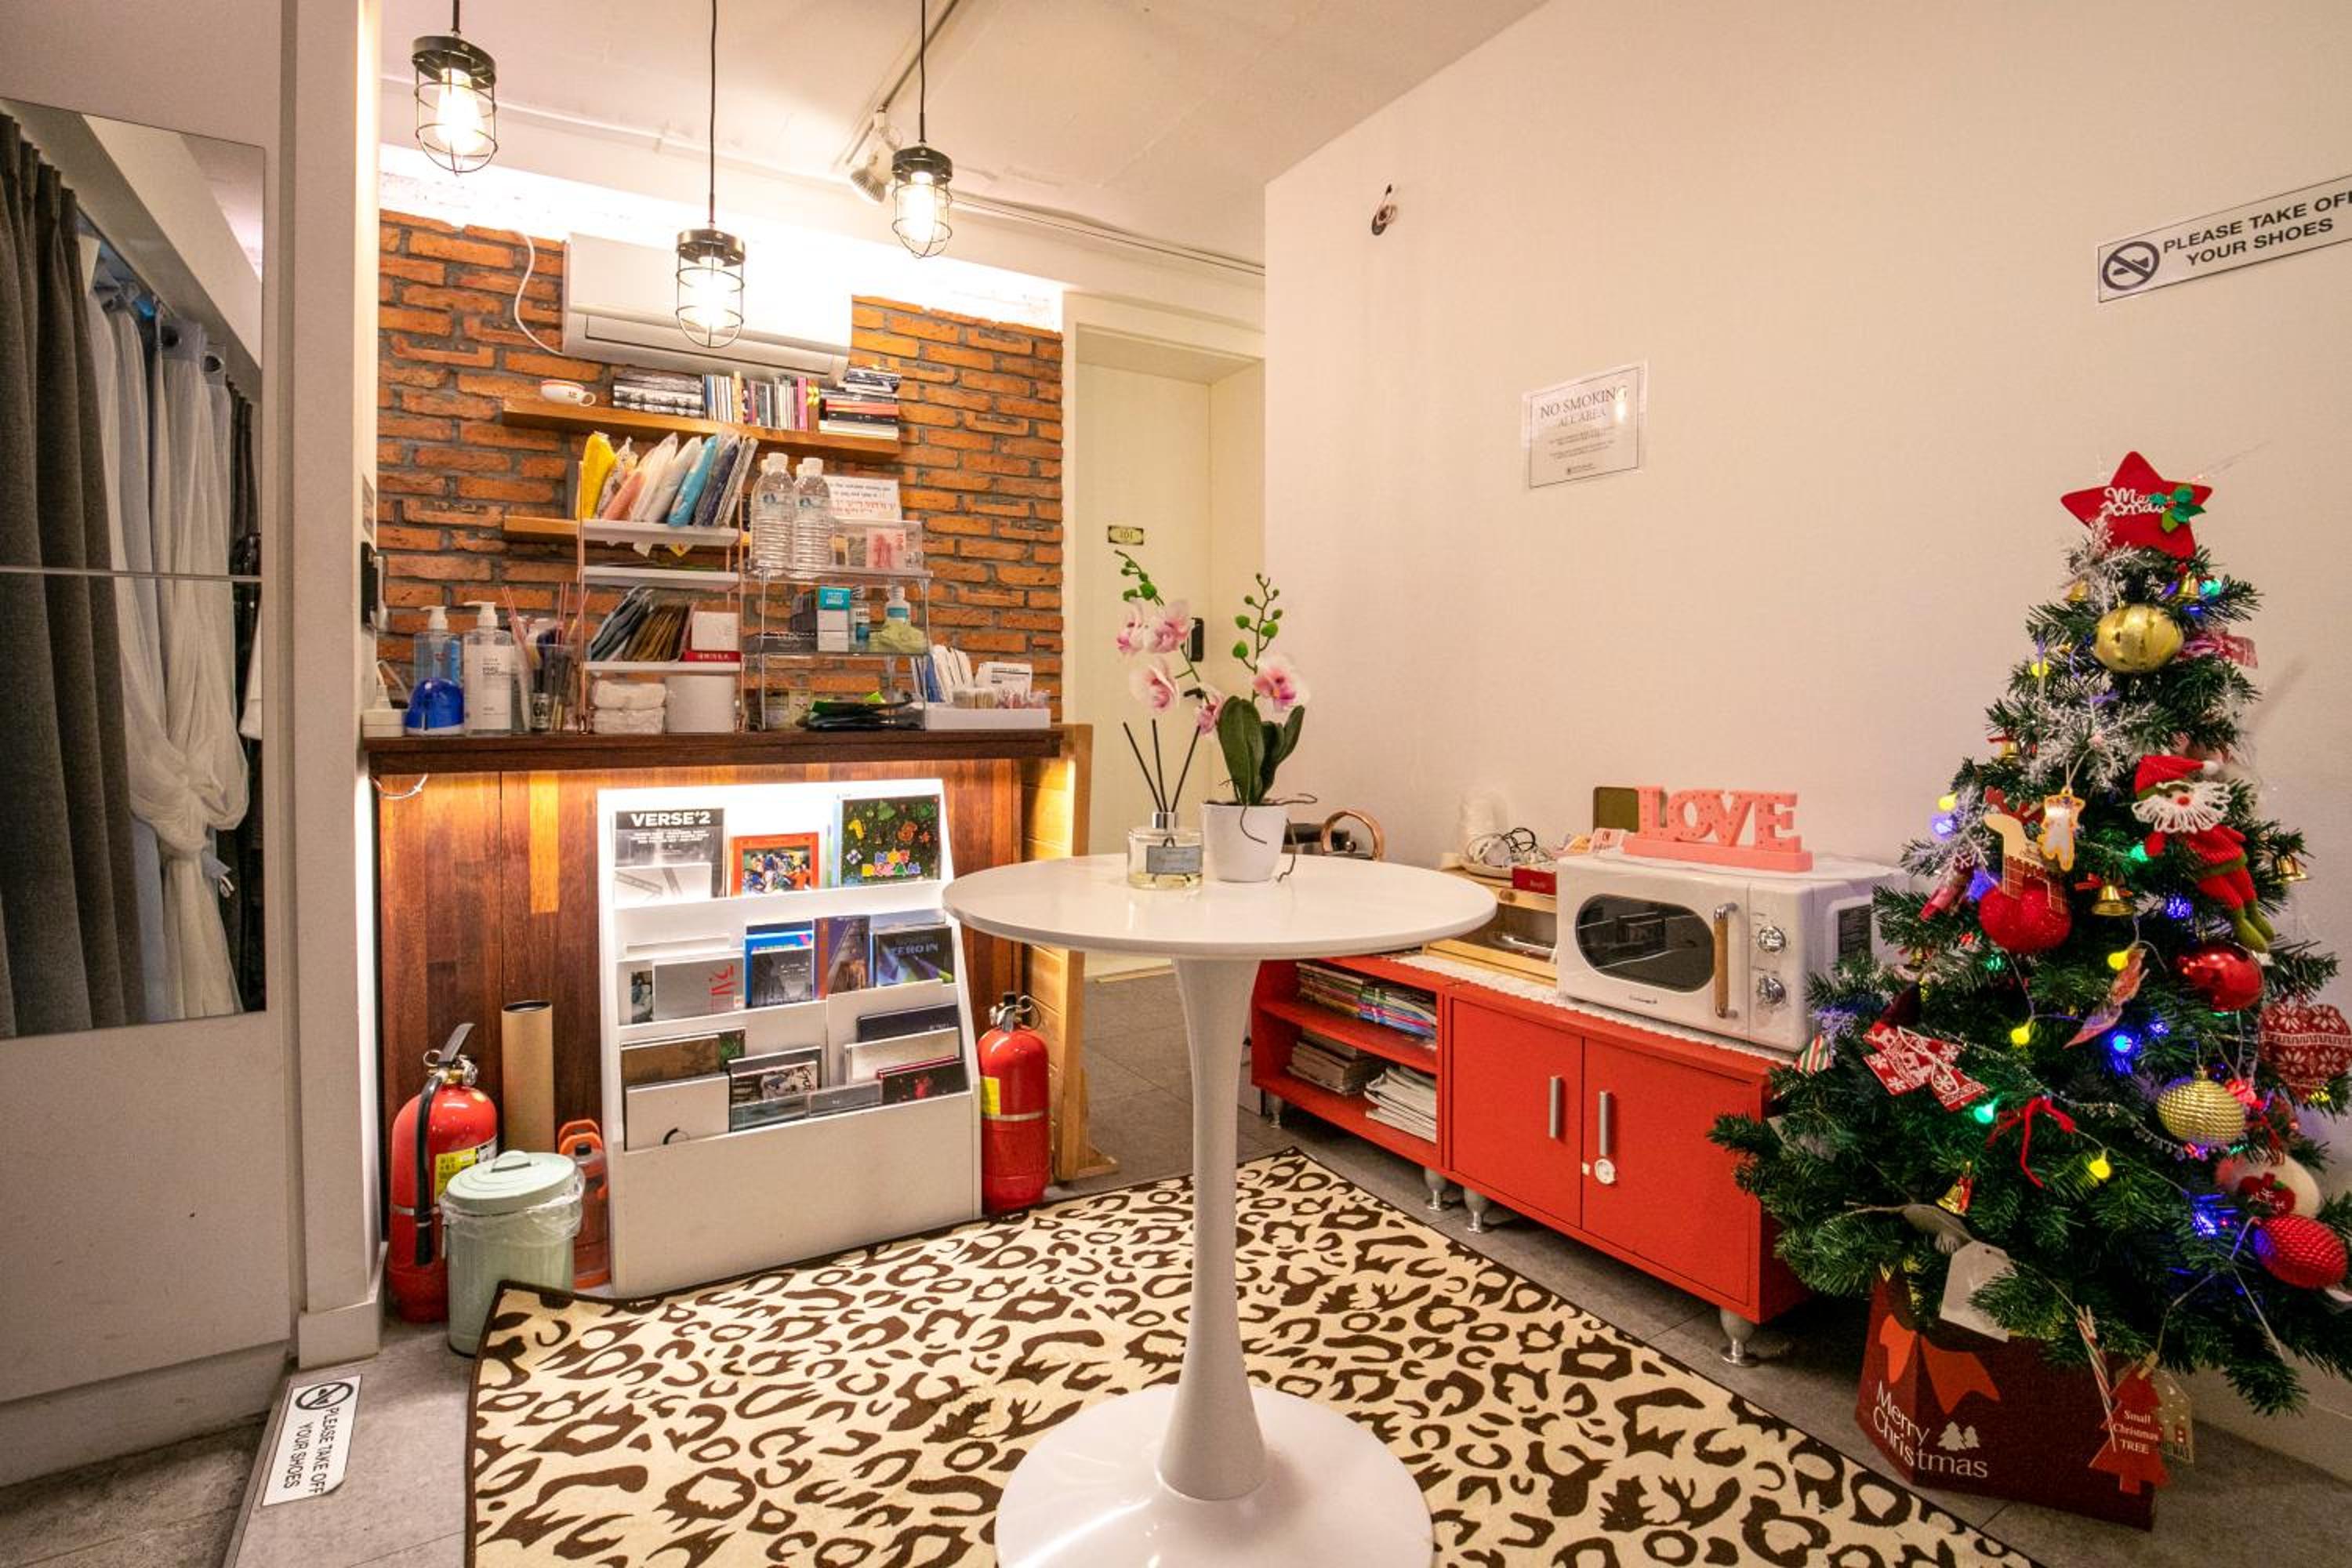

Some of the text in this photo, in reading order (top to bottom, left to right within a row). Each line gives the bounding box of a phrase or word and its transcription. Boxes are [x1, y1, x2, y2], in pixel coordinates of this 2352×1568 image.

[2163, 220, 2242, 253] PLEASE
[2249, 202, 2307, 229] TAKE
[2187, 218, 2333, 267] YOUR SHOES
[1540, 385, 1628, 419] NO SMOKING
[1580, 408, 1606, 423] AREA
[630, 811, 710, 827] VERSE'2
[1637, 785, 1802, 852] LOVE
[1876, 1380, 1930, 1446] Merry
[2112, 1423, 2159, 1441] Christmas
[2123, 1410, 2151, 1425] Small
[283, 1421, 314, 1489] YOUR SHOES
[309, 1407, 340, 1494] PLEASE TAKE OFF
[1873, 1406, 1989, 1479] Christmas
[2120, 1439, 2150, 1454] TREE
